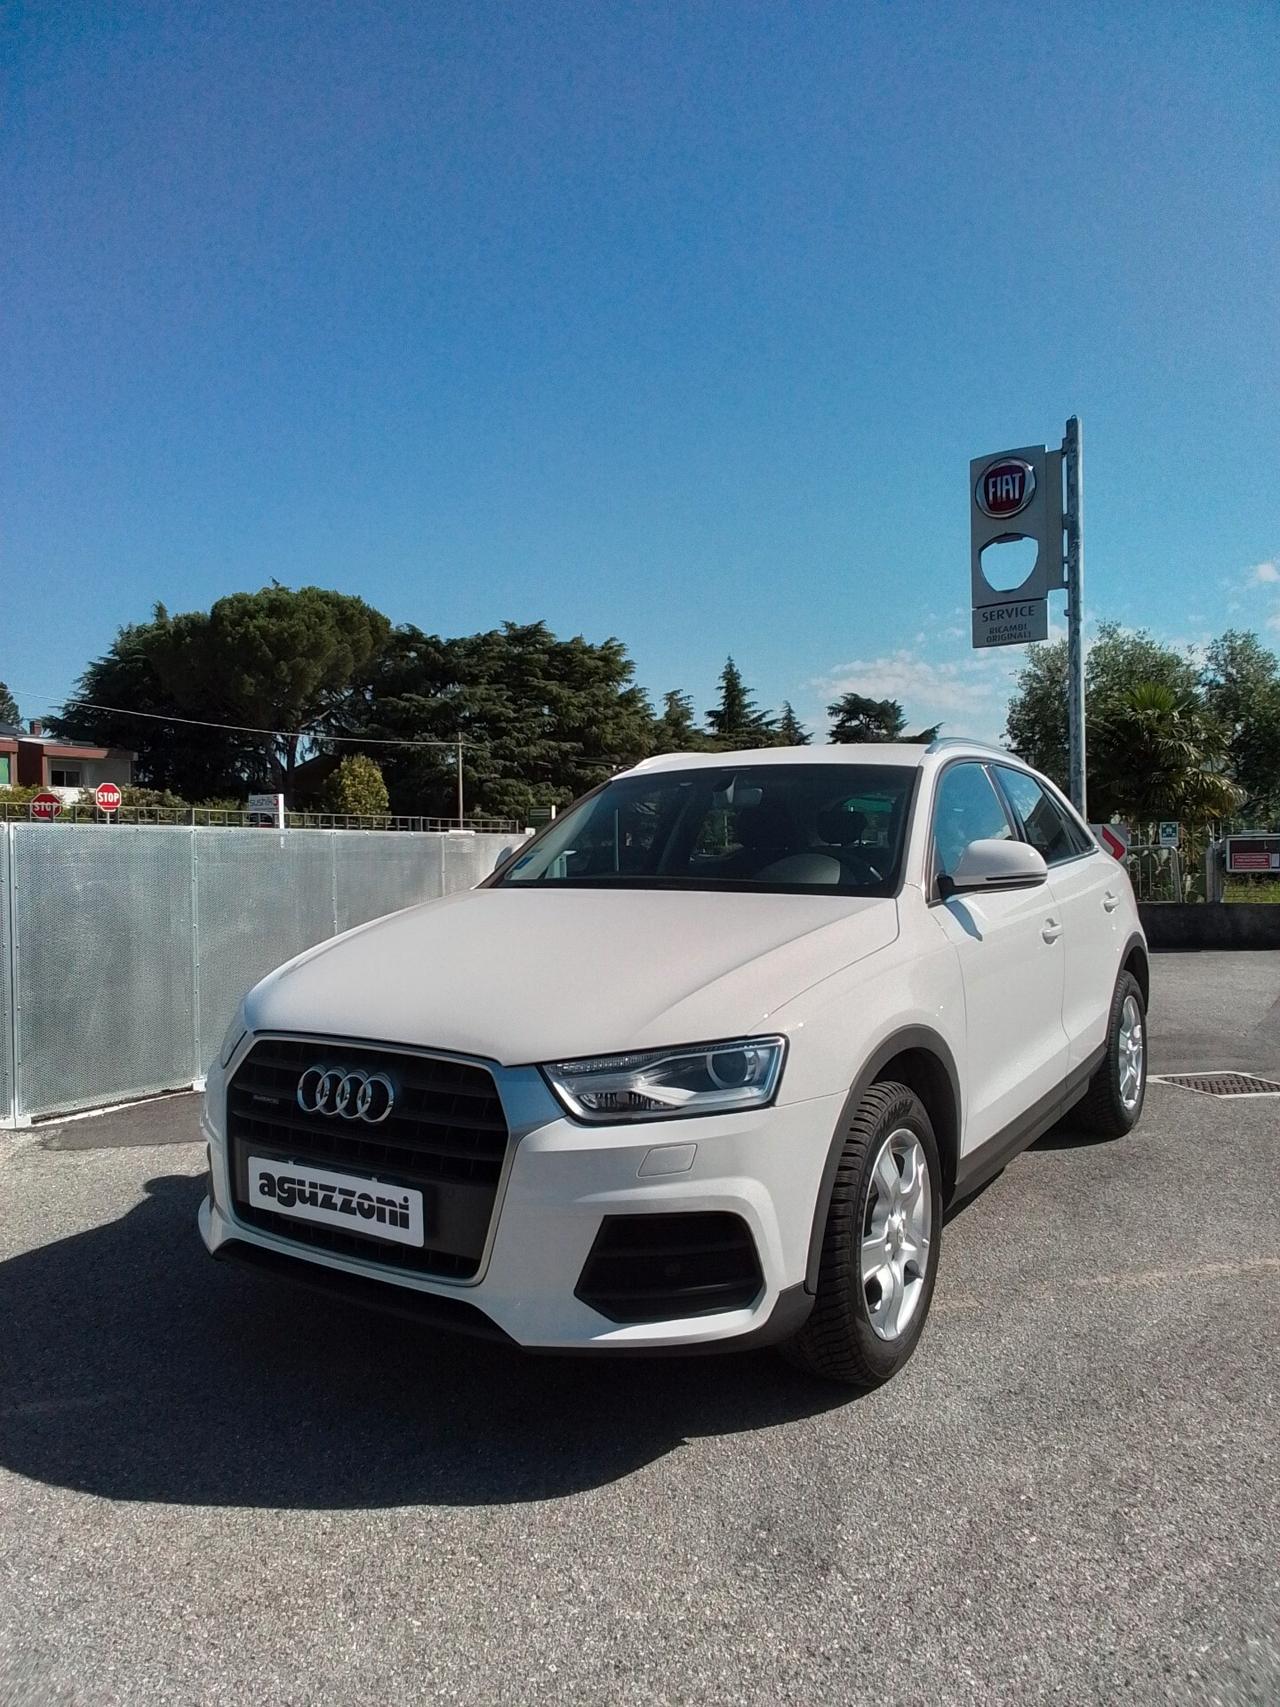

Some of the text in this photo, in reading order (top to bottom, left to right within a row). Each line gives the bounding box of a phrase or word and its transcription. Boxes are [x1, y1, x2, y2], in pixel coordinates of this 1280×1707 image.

[988, 472, 1023, 504] FIAT
[982, 605, 1036, 622] SERVICE
[989, 623, 1027, 634] RICAMBI
[986, 631, 1031, 643] ORIGINALI
[97, 792, 120, 803] STOP
[33, 802, 58, 812] STOP
[259, 1172, 409, 1229] aguzzoni
